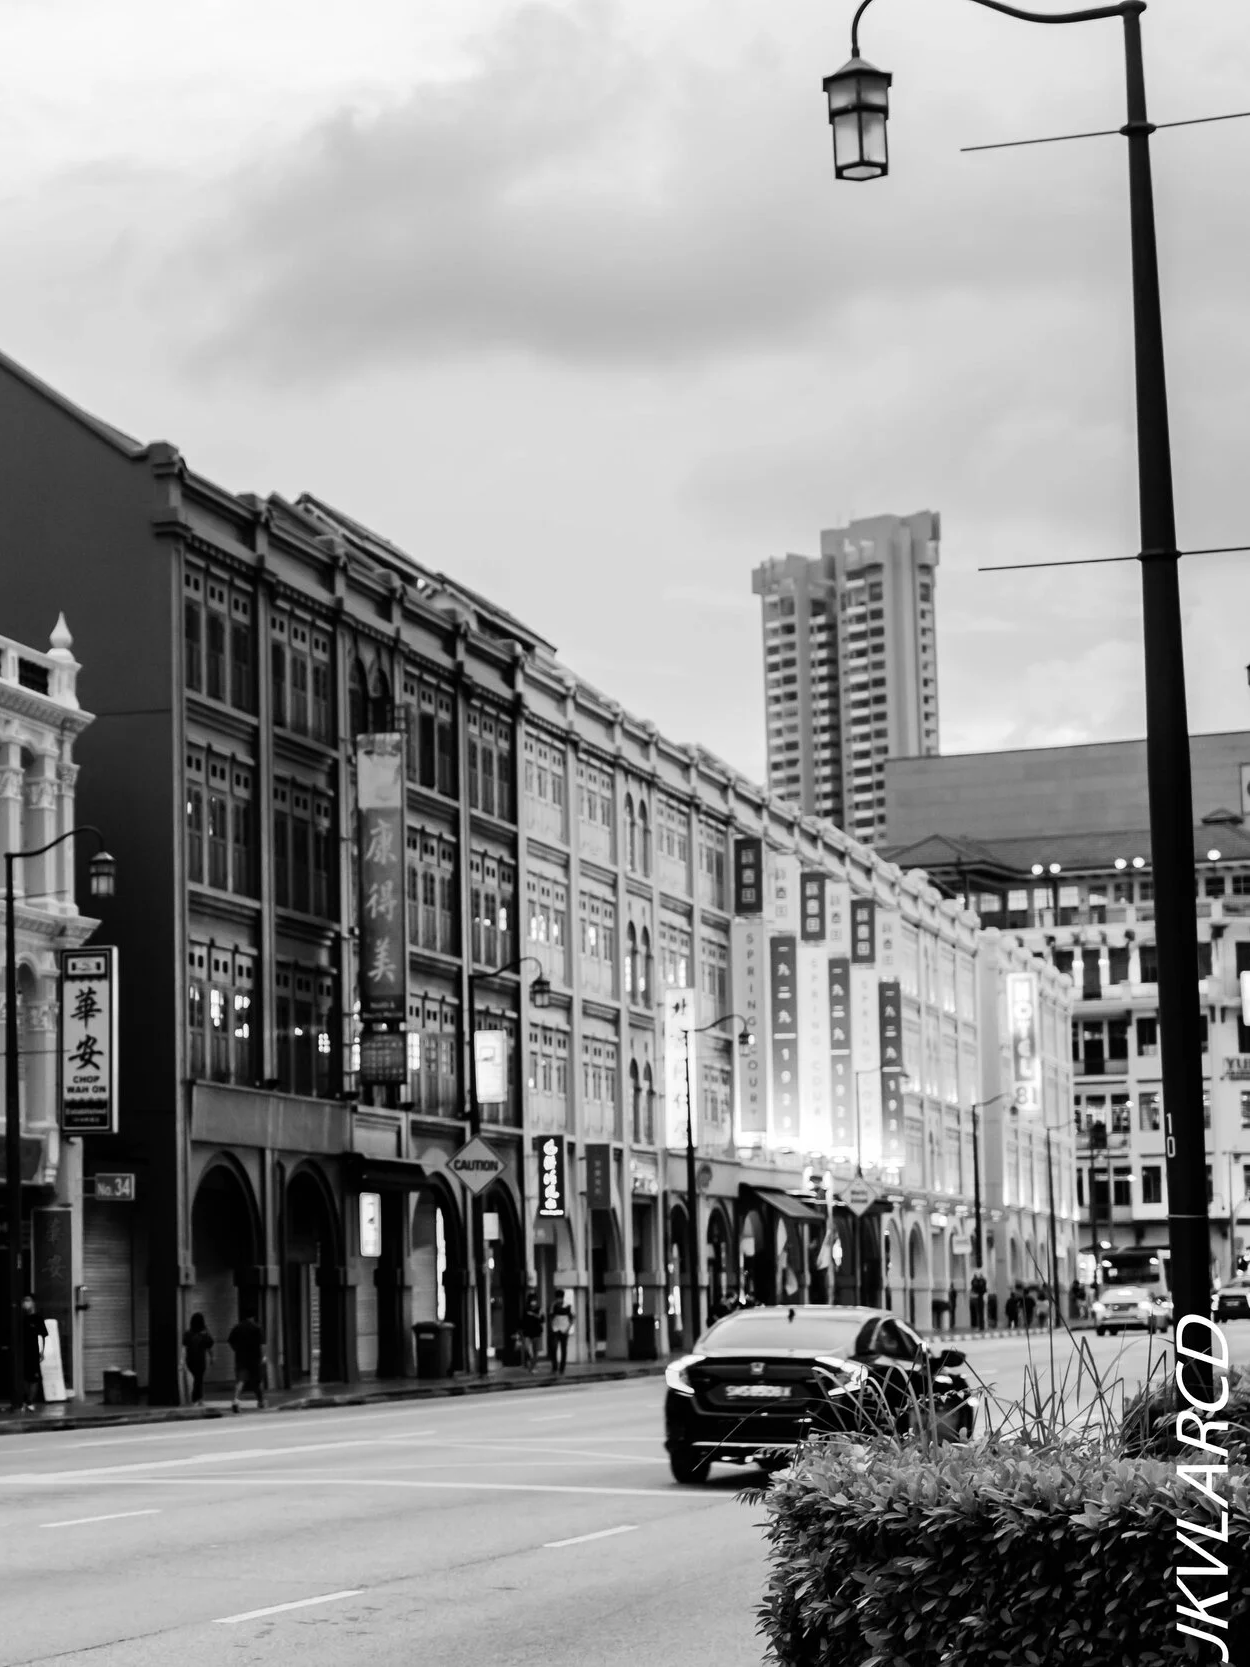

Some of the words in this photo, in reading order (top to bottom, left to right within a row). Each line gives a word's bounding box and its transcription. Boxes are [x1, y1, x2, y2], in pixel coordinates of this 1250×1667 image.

[68, 986, 105, 1071] 華安
[72, 1075, 100, 1084] CHOP
[66, 1085, 89, 1094] WAH
[92, 1084, 106, 1094] ON
[453, 1159, 499, 1172] CAUTION
[114, 1177, 130, 1197] 34
